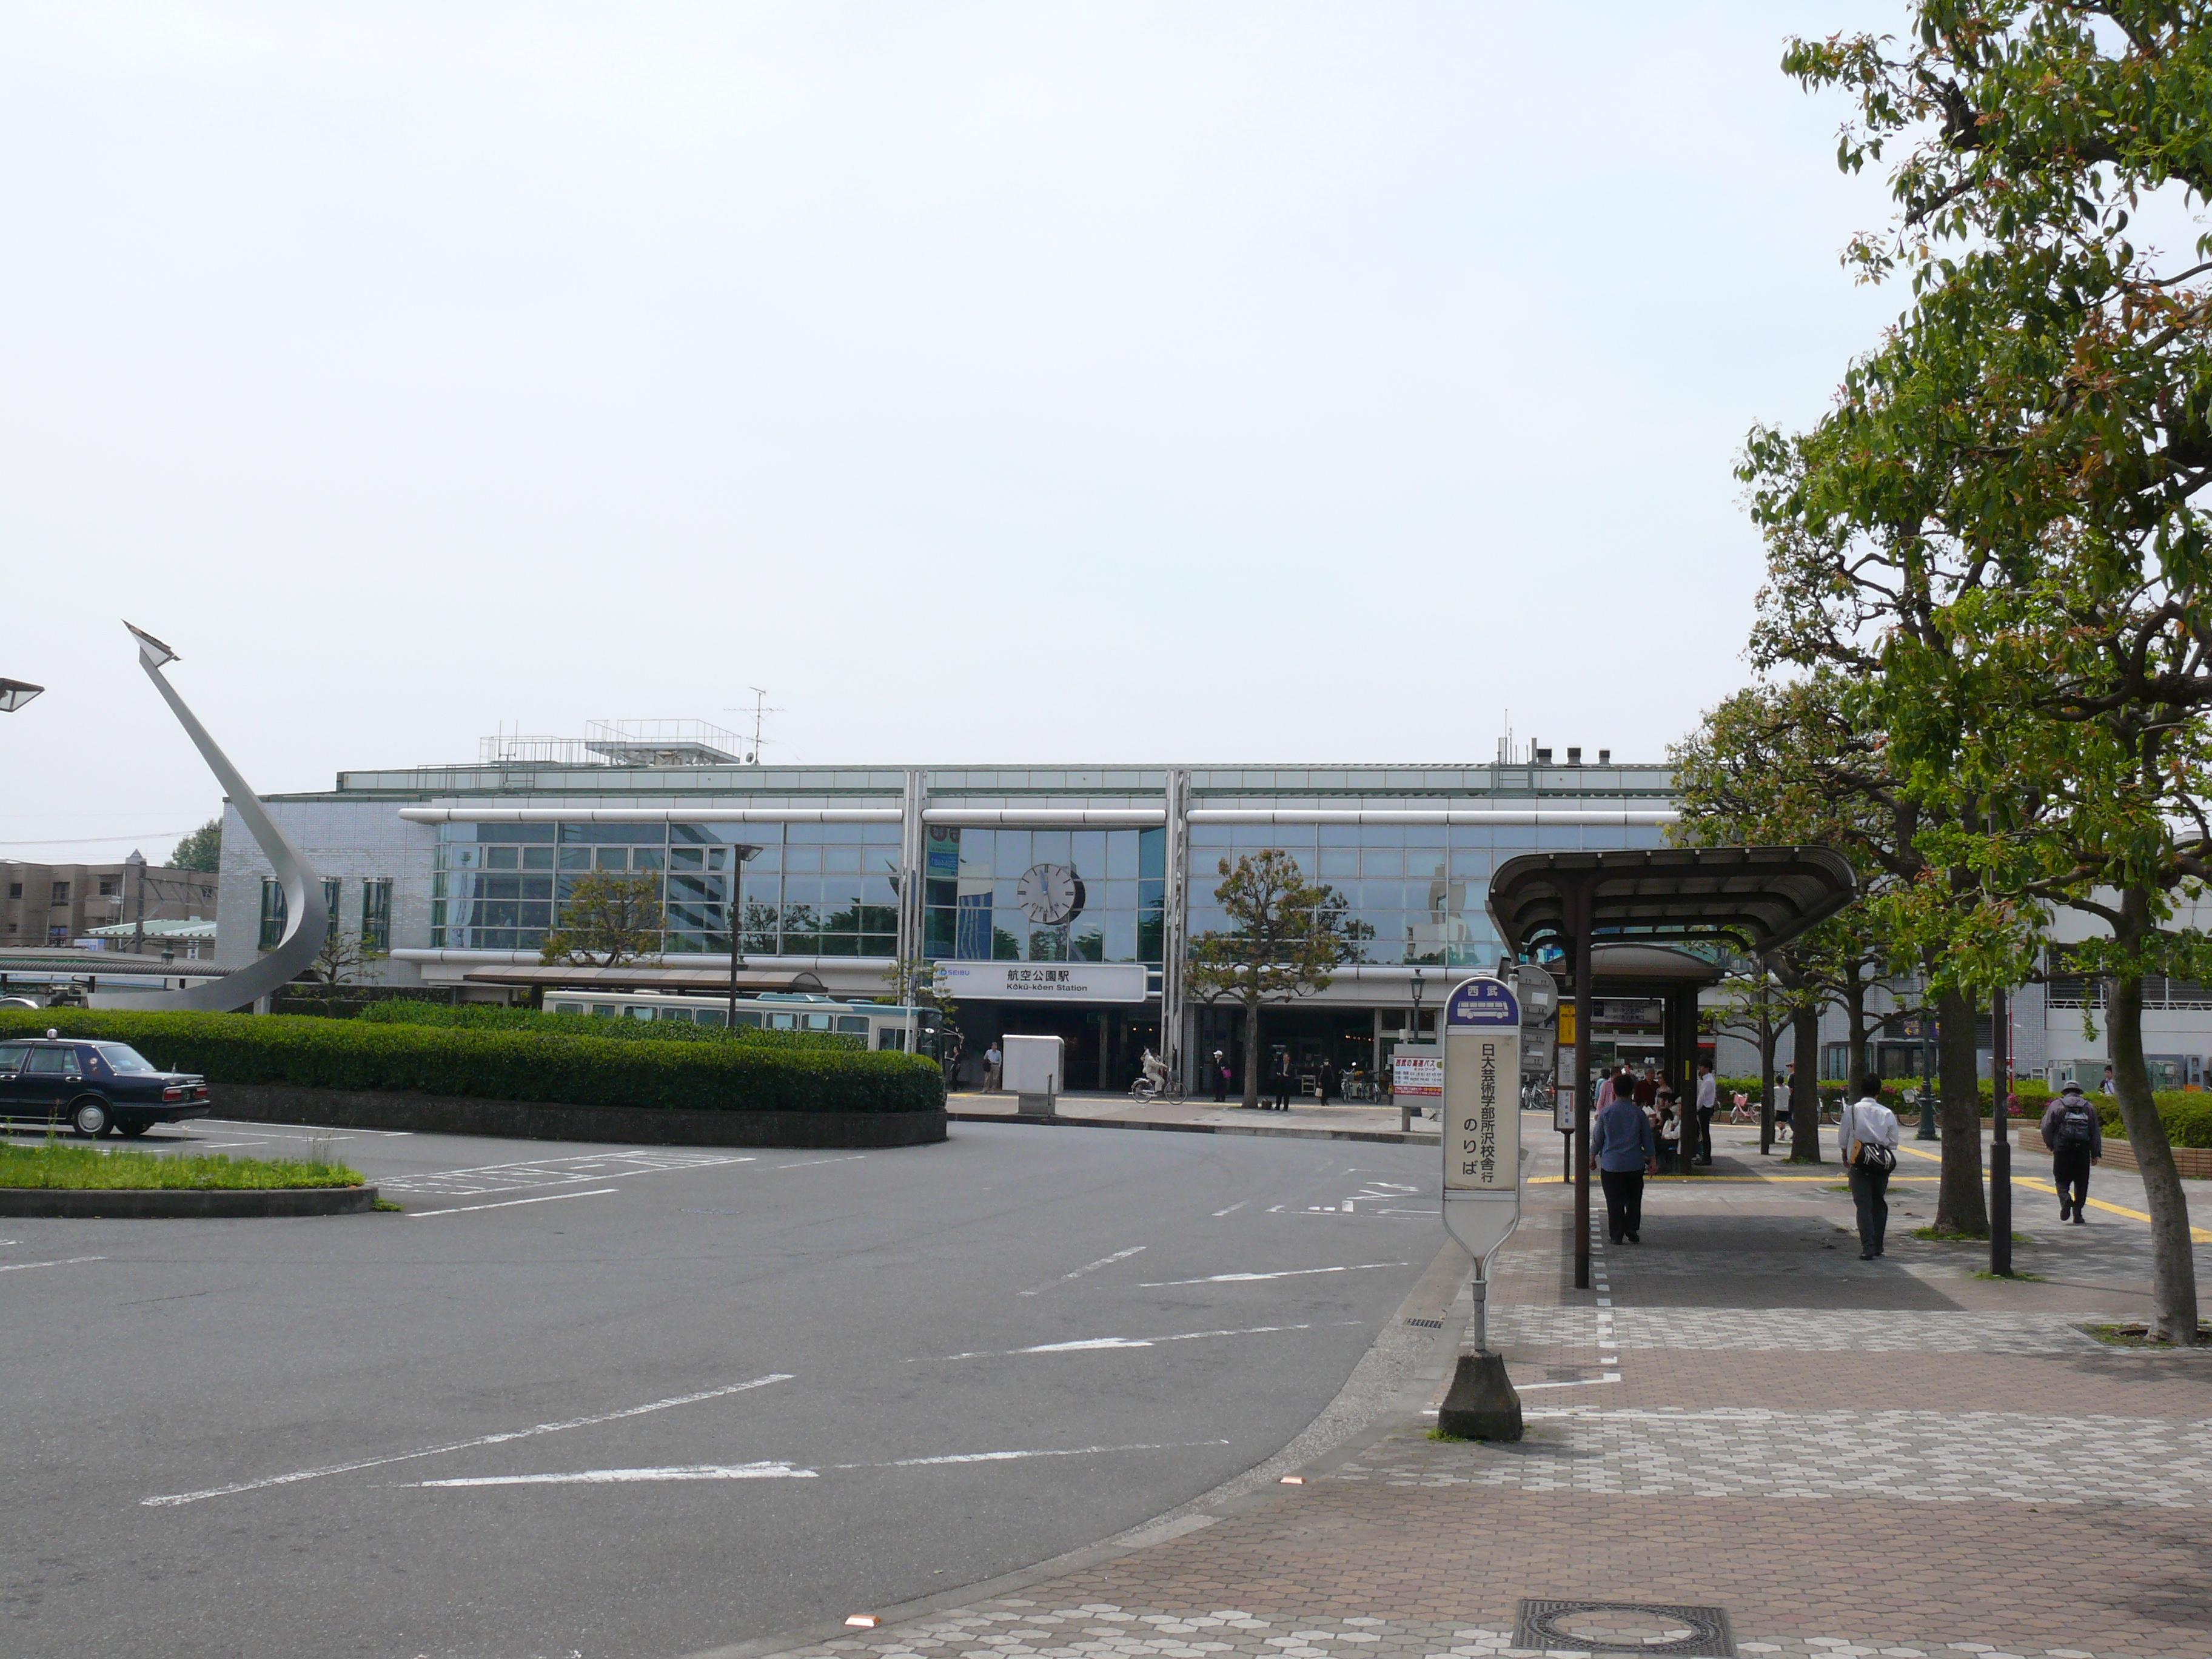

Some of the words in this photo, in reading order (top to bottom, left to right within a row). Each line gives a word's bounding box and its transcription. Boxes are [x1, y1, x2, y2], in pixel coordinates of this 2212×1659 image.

[1007, 969, 1070, 982] 航空公園駅
[1467, 985, 1499, 996] 西武
[1480, 1044, 1495, 1183] 日大芸術学部所沢校舎行
[1463, 1118, 1478, 1175] のりば
